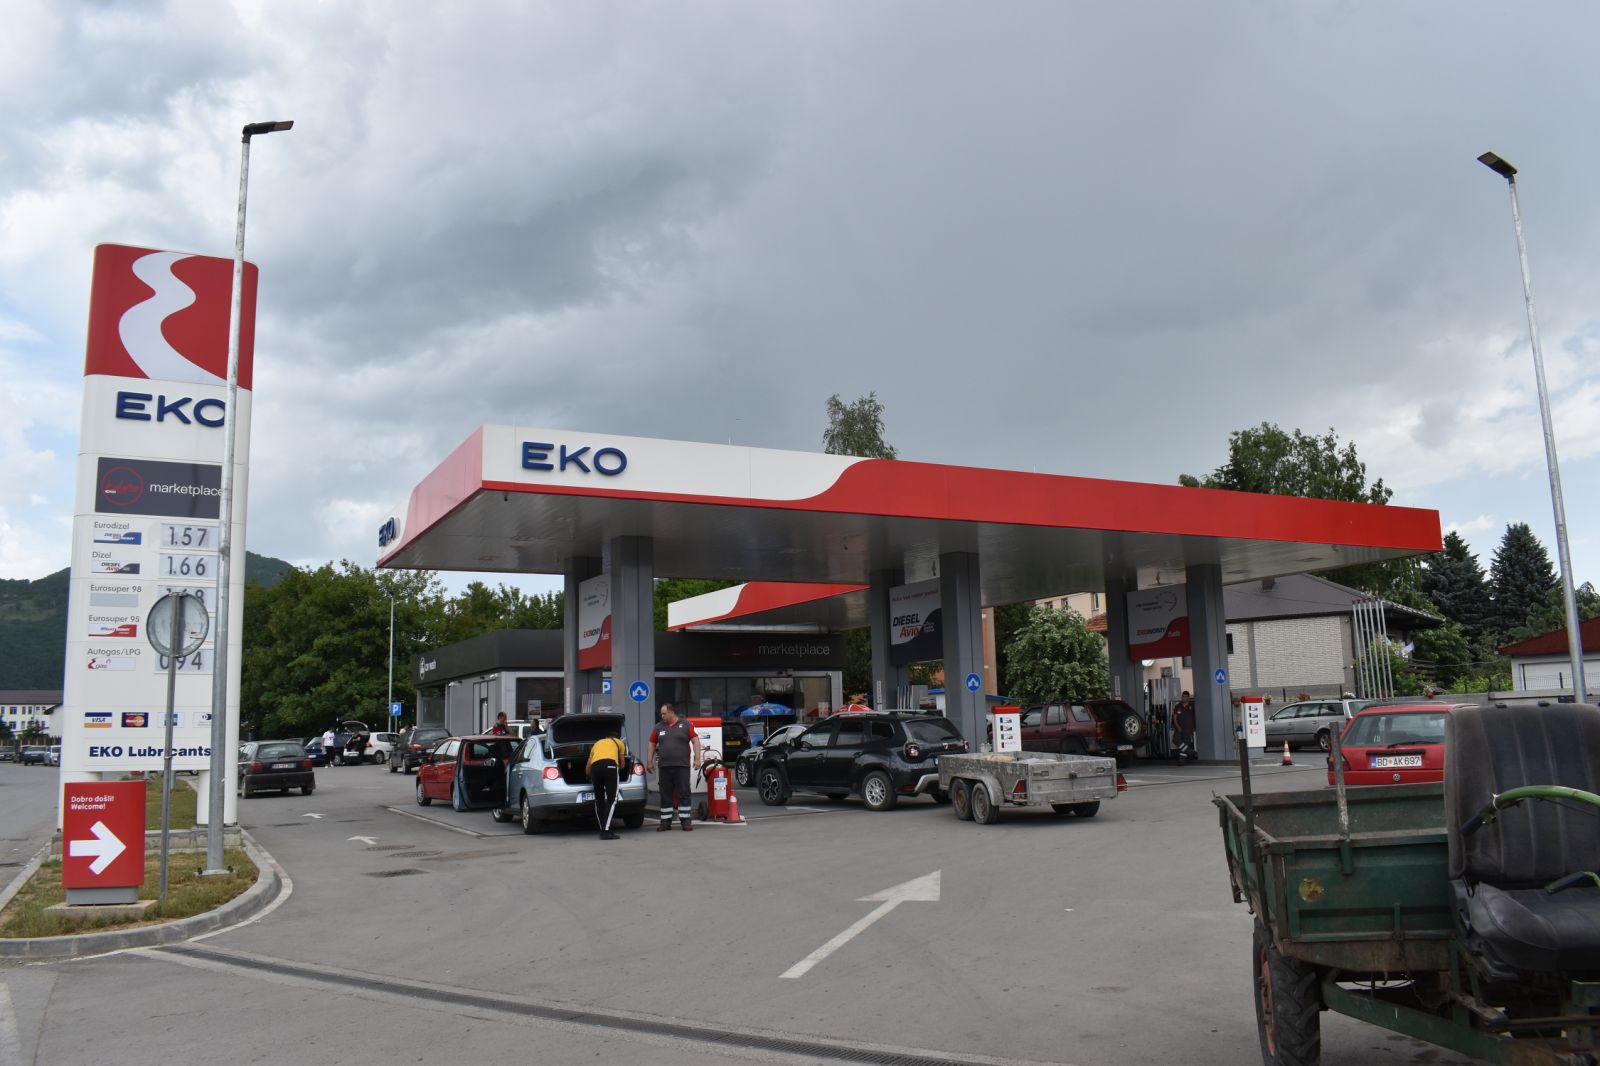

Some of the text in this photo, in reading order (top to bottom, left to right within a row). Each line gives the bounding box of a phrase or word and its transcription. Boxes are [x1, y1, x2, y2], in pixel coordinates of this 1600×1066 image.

[116, 391, 225, 428] EKO
[522, 441, 628, 476] EKO
[149, 483, 222, 497] marketplace
[94, 521, 130, 530] Eurodizel
[92, 551, 112, 559] Dizel
[90, 584, 142, 593] Eurosuper 98
[88, 614, 128, 624] Eurosuper
[892, 613, 920, 627] DIESEL
[87, 647, 141, 656] Autogas/LPG
[758, 644, 830, 657] marketplace
[602, 681, 611, 694] P
[392, 704, 399, 714] P
[89, 746, 212, 757] EKO Lubrcants
[71, 795, 93, 803] Dobro
